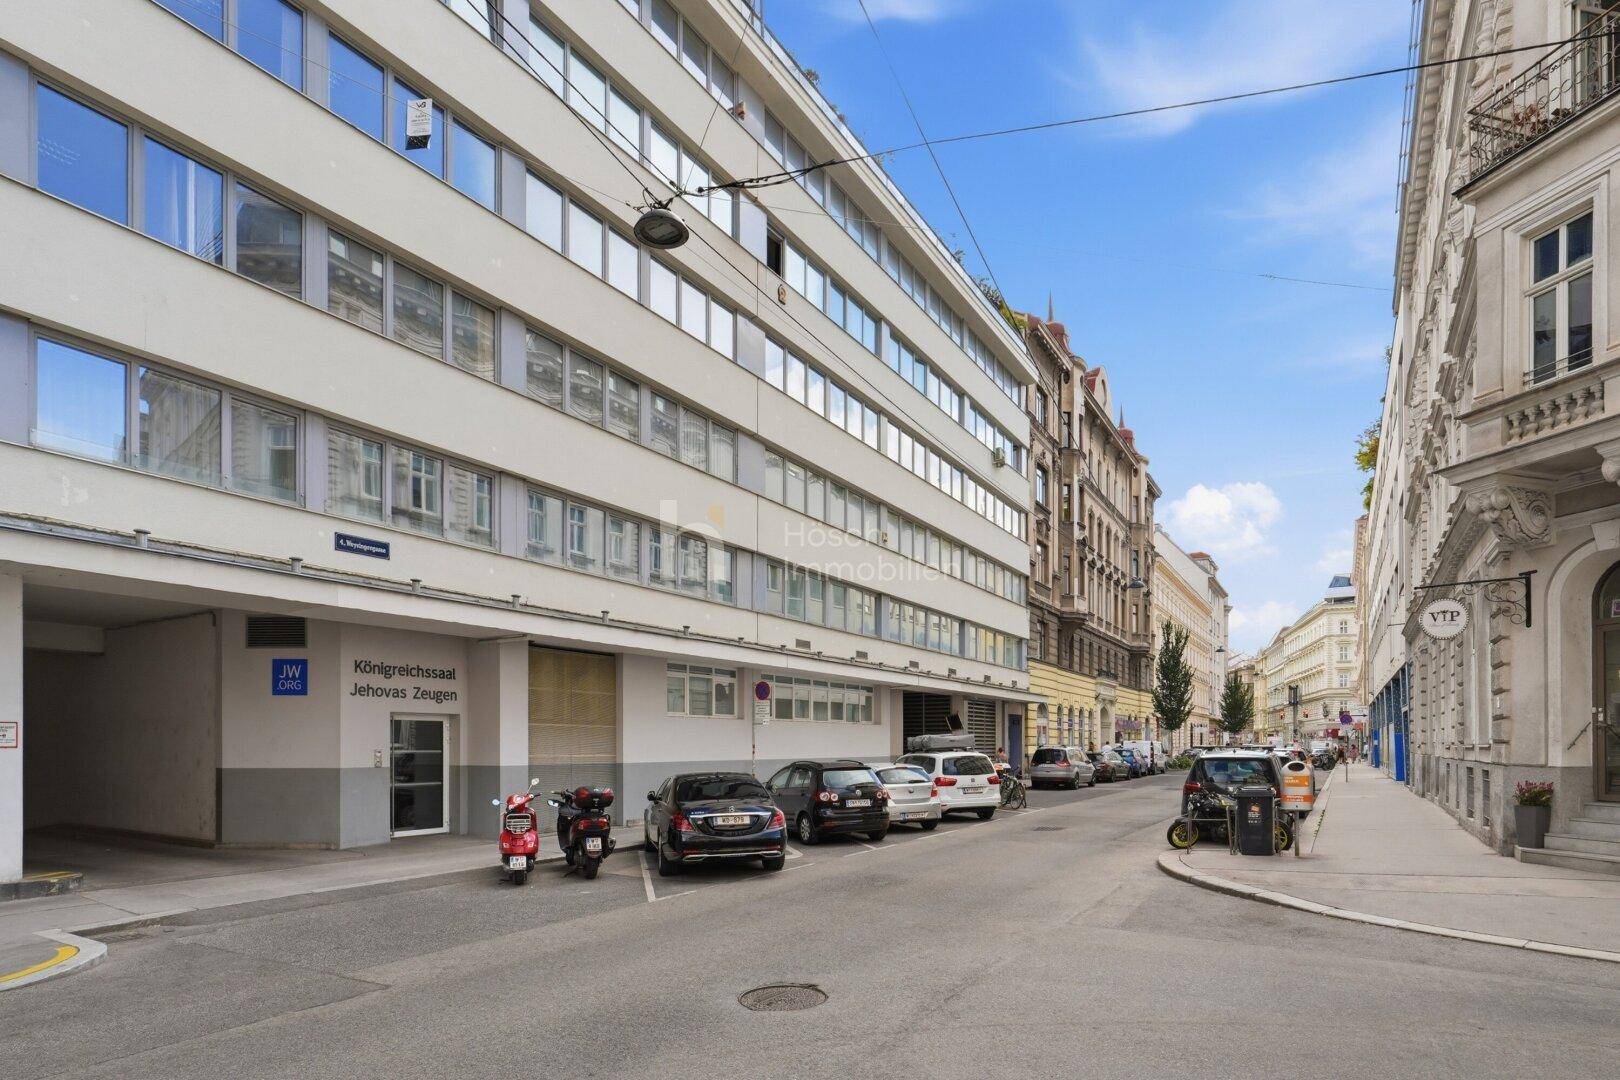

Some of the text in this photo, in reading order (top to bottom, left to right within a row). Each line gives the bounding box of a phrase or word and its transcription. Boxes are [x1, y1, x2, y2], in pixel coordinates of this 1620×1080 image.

[279, 664, 302, 678] JW
[354, 659, 456, 680] Königreichssaal
[276, 679, 302, 690] .ORG
[350, 682, 458, 704] Jehovas Zeugen
